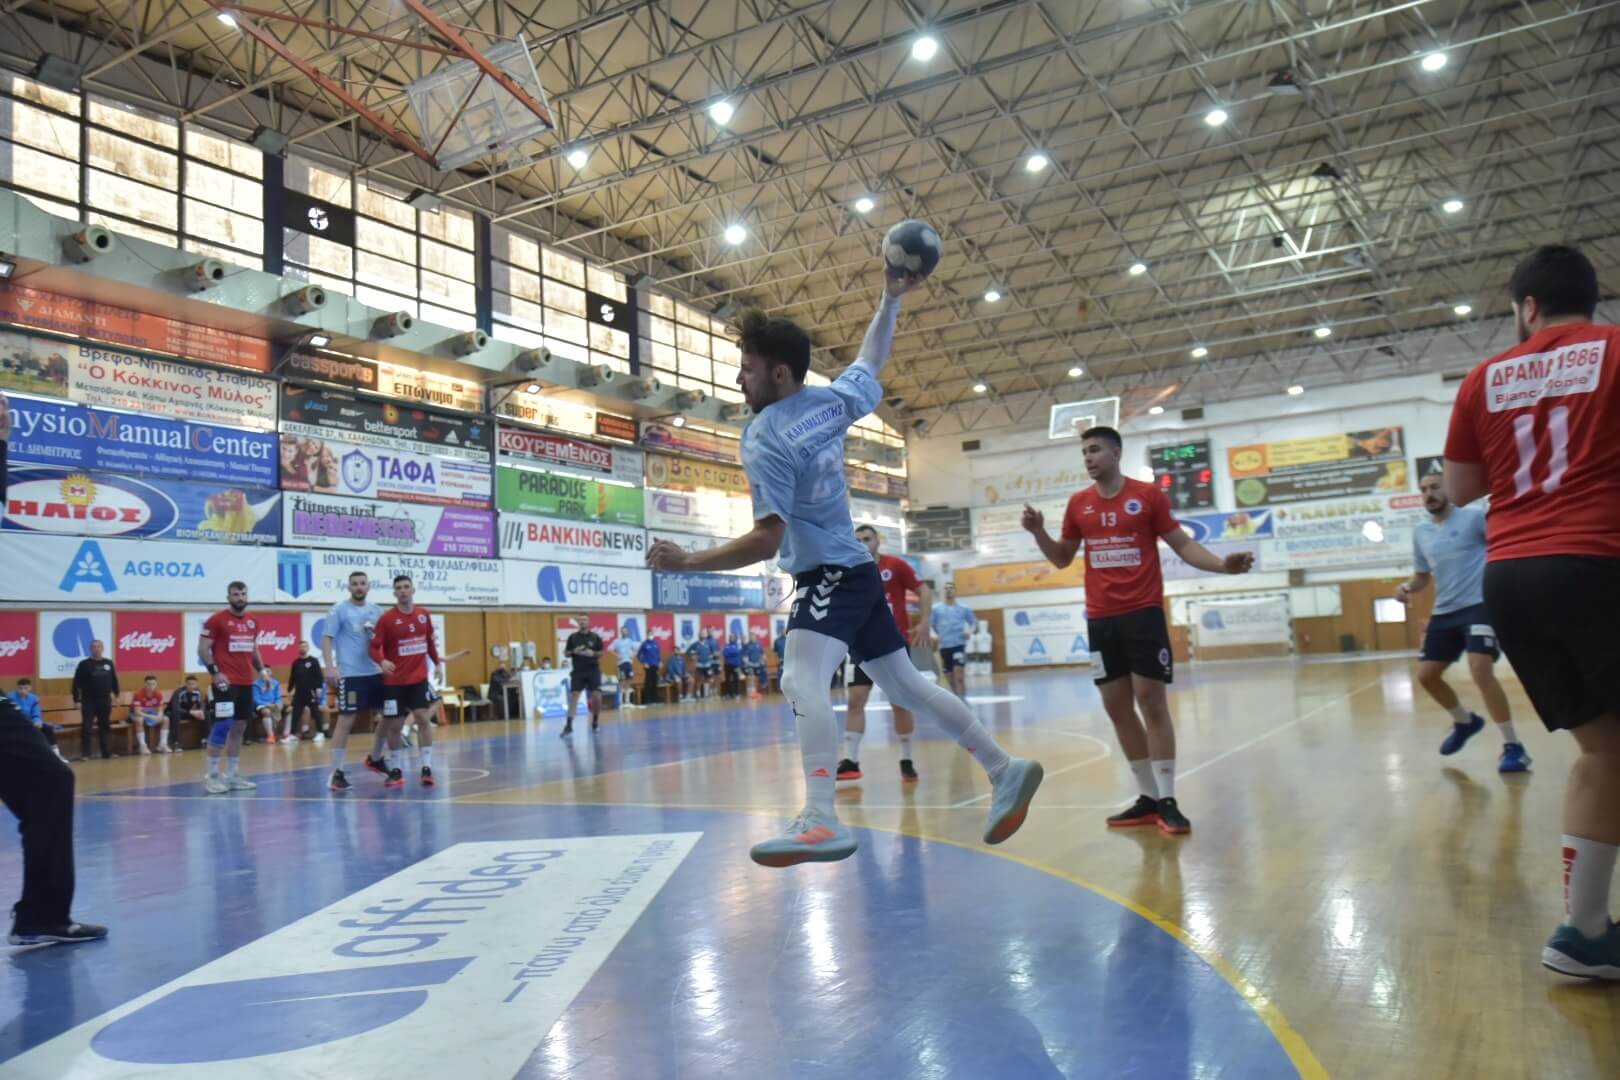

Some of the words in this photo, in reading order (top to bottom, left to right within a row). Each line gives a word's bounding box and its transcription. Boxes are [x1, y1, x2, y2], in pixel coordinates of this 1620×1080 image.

[1557, 346, 1600, 370] 1986
[113, 368, 202, 399] Κόκκινος
[364, 418, 418, 439] bettersport
[500, 431, 609, 466] ΚΟΥΡΕΜΕΝΟΣ
[1512, 405, 1570, 498] 11
[377, 455, 436, 485] ΤΑΦΑ
[519, 471, 586, 500] PARADISE
[8, 499, 141, 523] ΗΛΙΟΣ
[1101, 511, 1118, 527] 13
[527, 522, 644, 551] BANKINGNEWS
[123, 560, 206, 578] AGROZA
[323, 552, 370, 568] ΙΩΝΙΚΟΣ
[399, 558, 426, 570] ΝΕΑΣ
[428, 559, 499, 573] ΦΙΛΑΔΕΛΦΕΙΑΣ
[422, 570, 448, 582] 2022
[567, 573, 629, 597] affidea
[119, 631, 176, 653] Kellogg's
[333, 849, 568, 958] affidea
